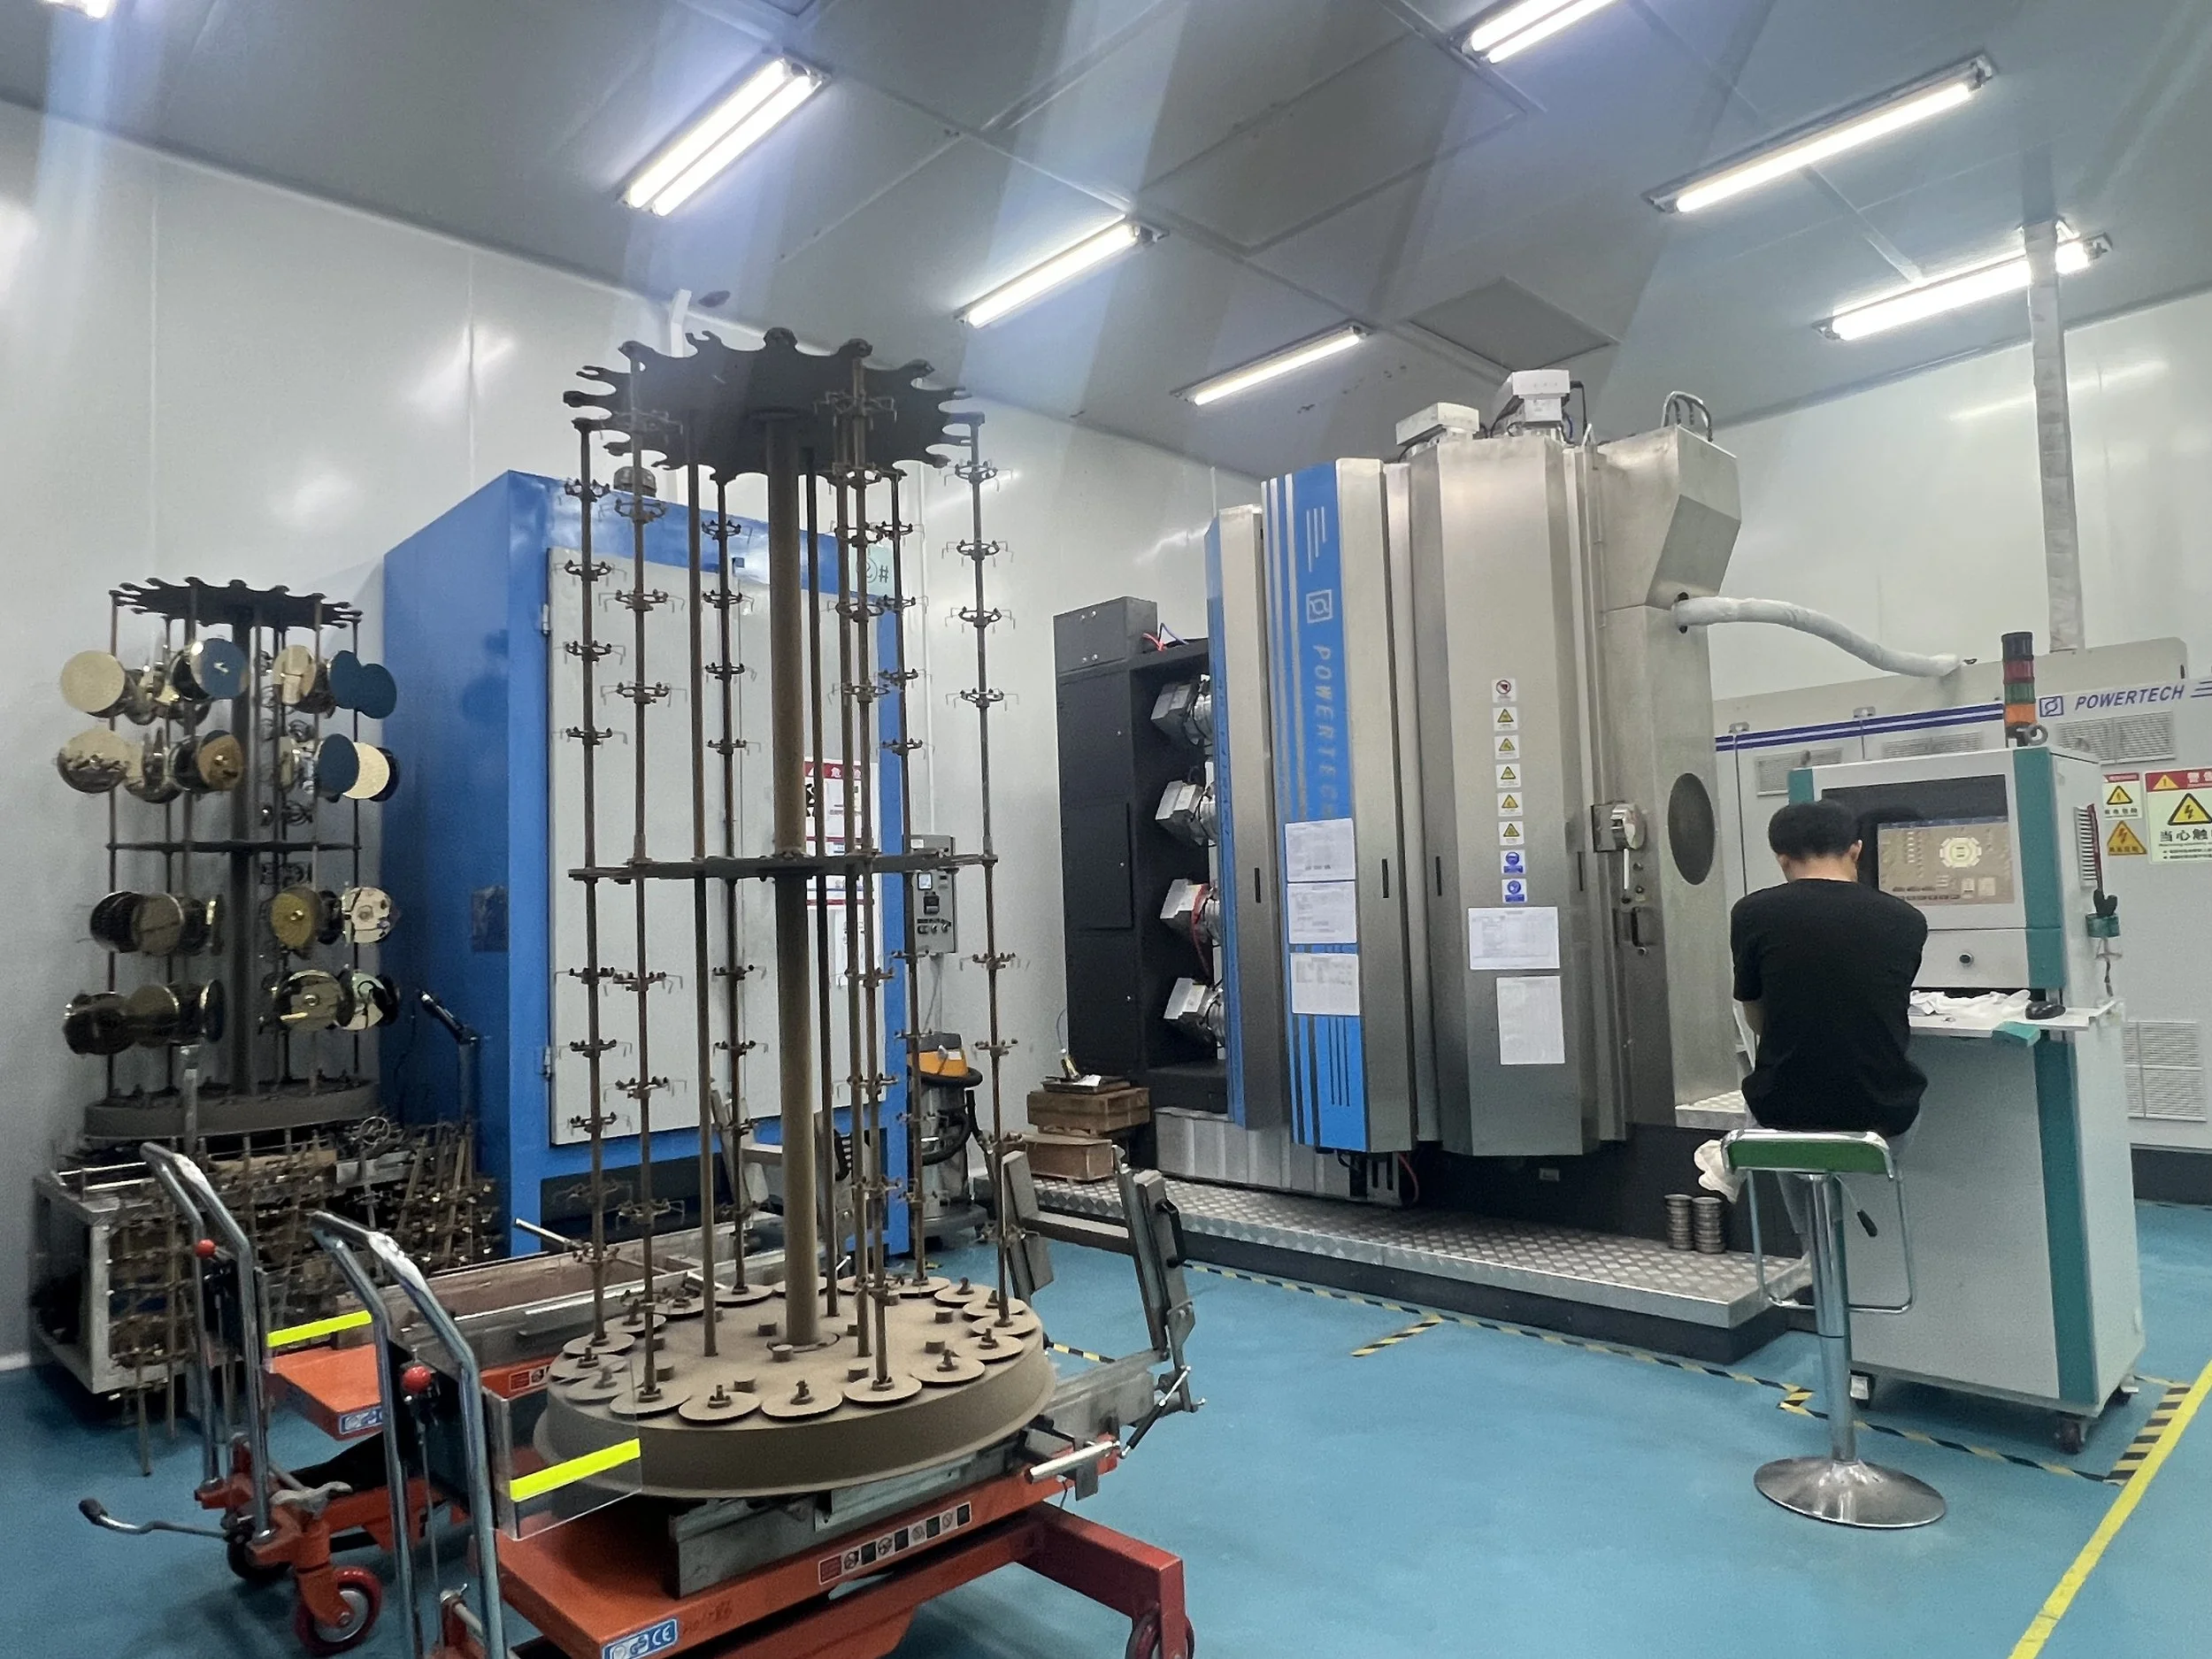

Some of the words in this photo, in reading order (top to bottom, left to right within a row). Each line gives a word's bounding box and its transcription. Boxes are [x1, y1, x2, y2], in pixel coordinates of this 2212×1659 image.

[2075, 685, 2185, 710] POWERTECH
[2160, 828, 2212, 842] 当心触
[652, 1624, 672, 1646] CE
